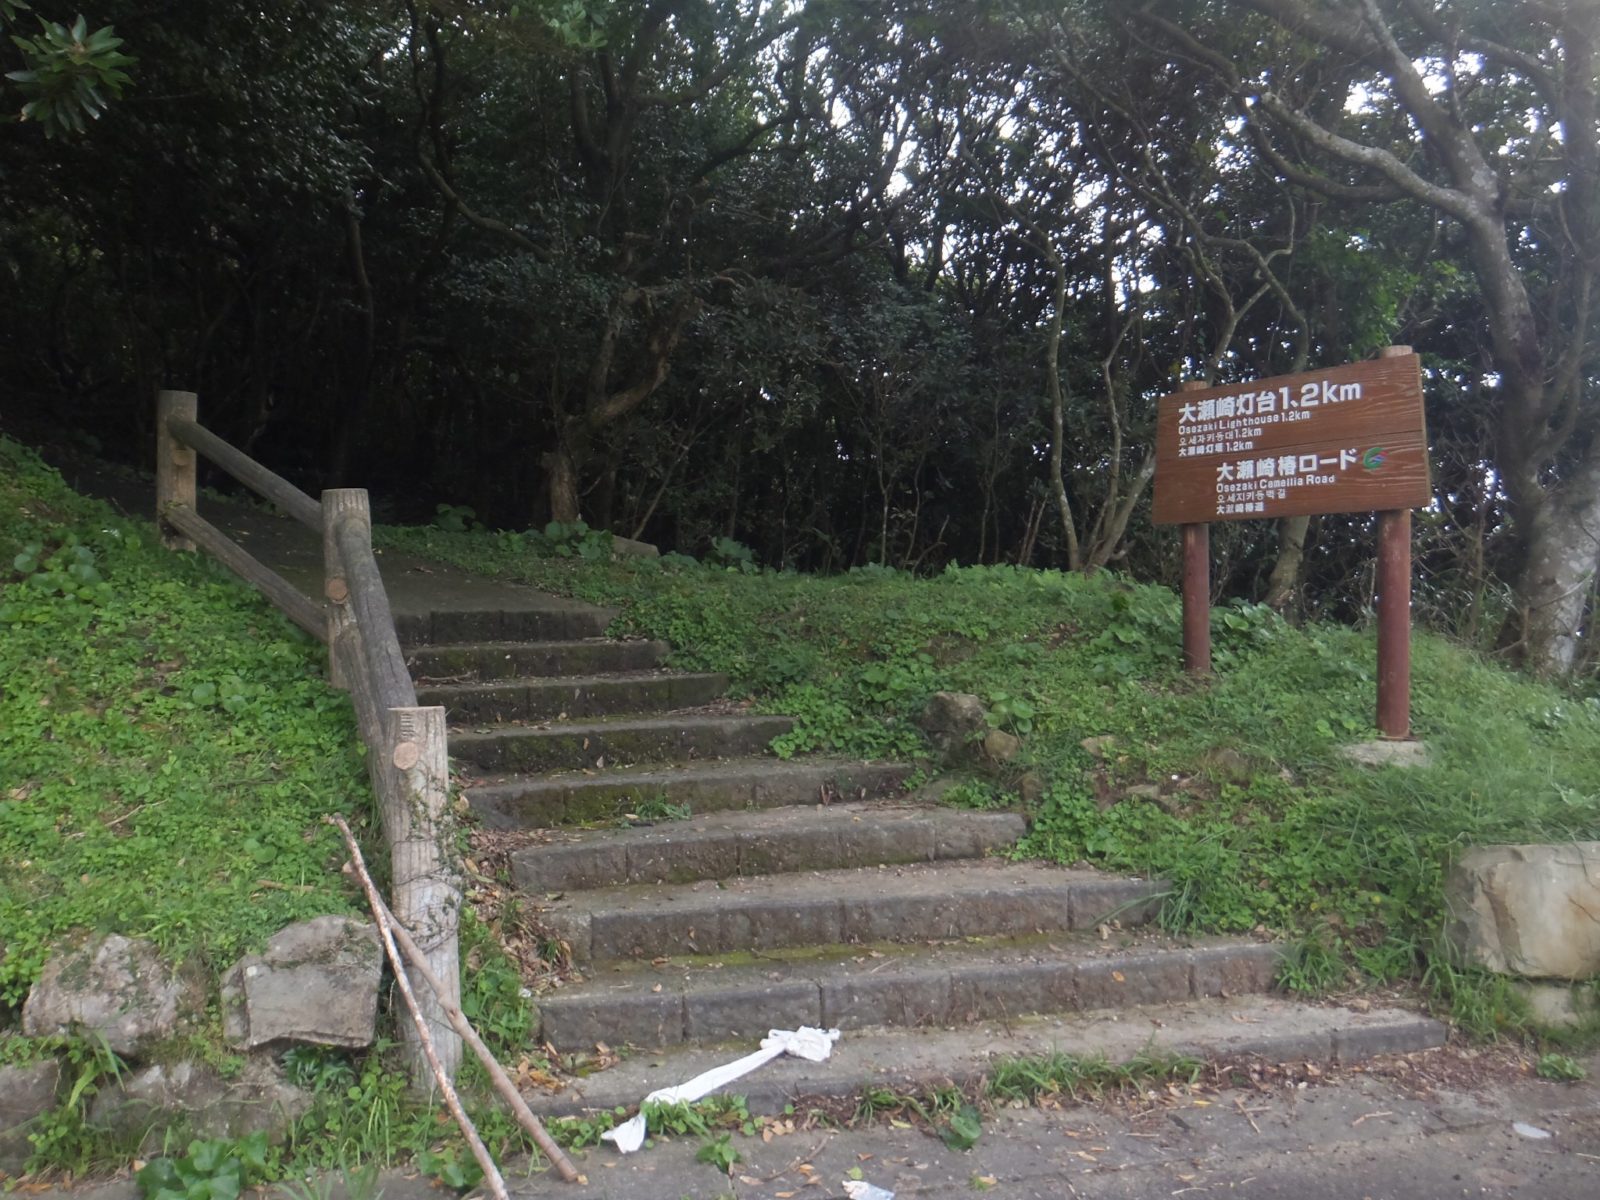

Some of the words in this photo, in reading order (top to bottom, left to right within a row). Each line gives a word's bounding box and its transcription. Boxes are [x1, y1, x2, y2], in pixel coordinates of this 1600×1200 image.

[1178, 421, 1217, 435] Osezaki
[1219, 414, 1280, 430] Lighthouse
[1281, 410, 1311, 422] 1.2km
[1216, 448, 1358, 481] 大瀬崎椿ロード
[1216, 479, 1257, 493] Osezaki
[1259, 476, 1303, 489] Camellia
[1306, 474, 1336, 485] Road
